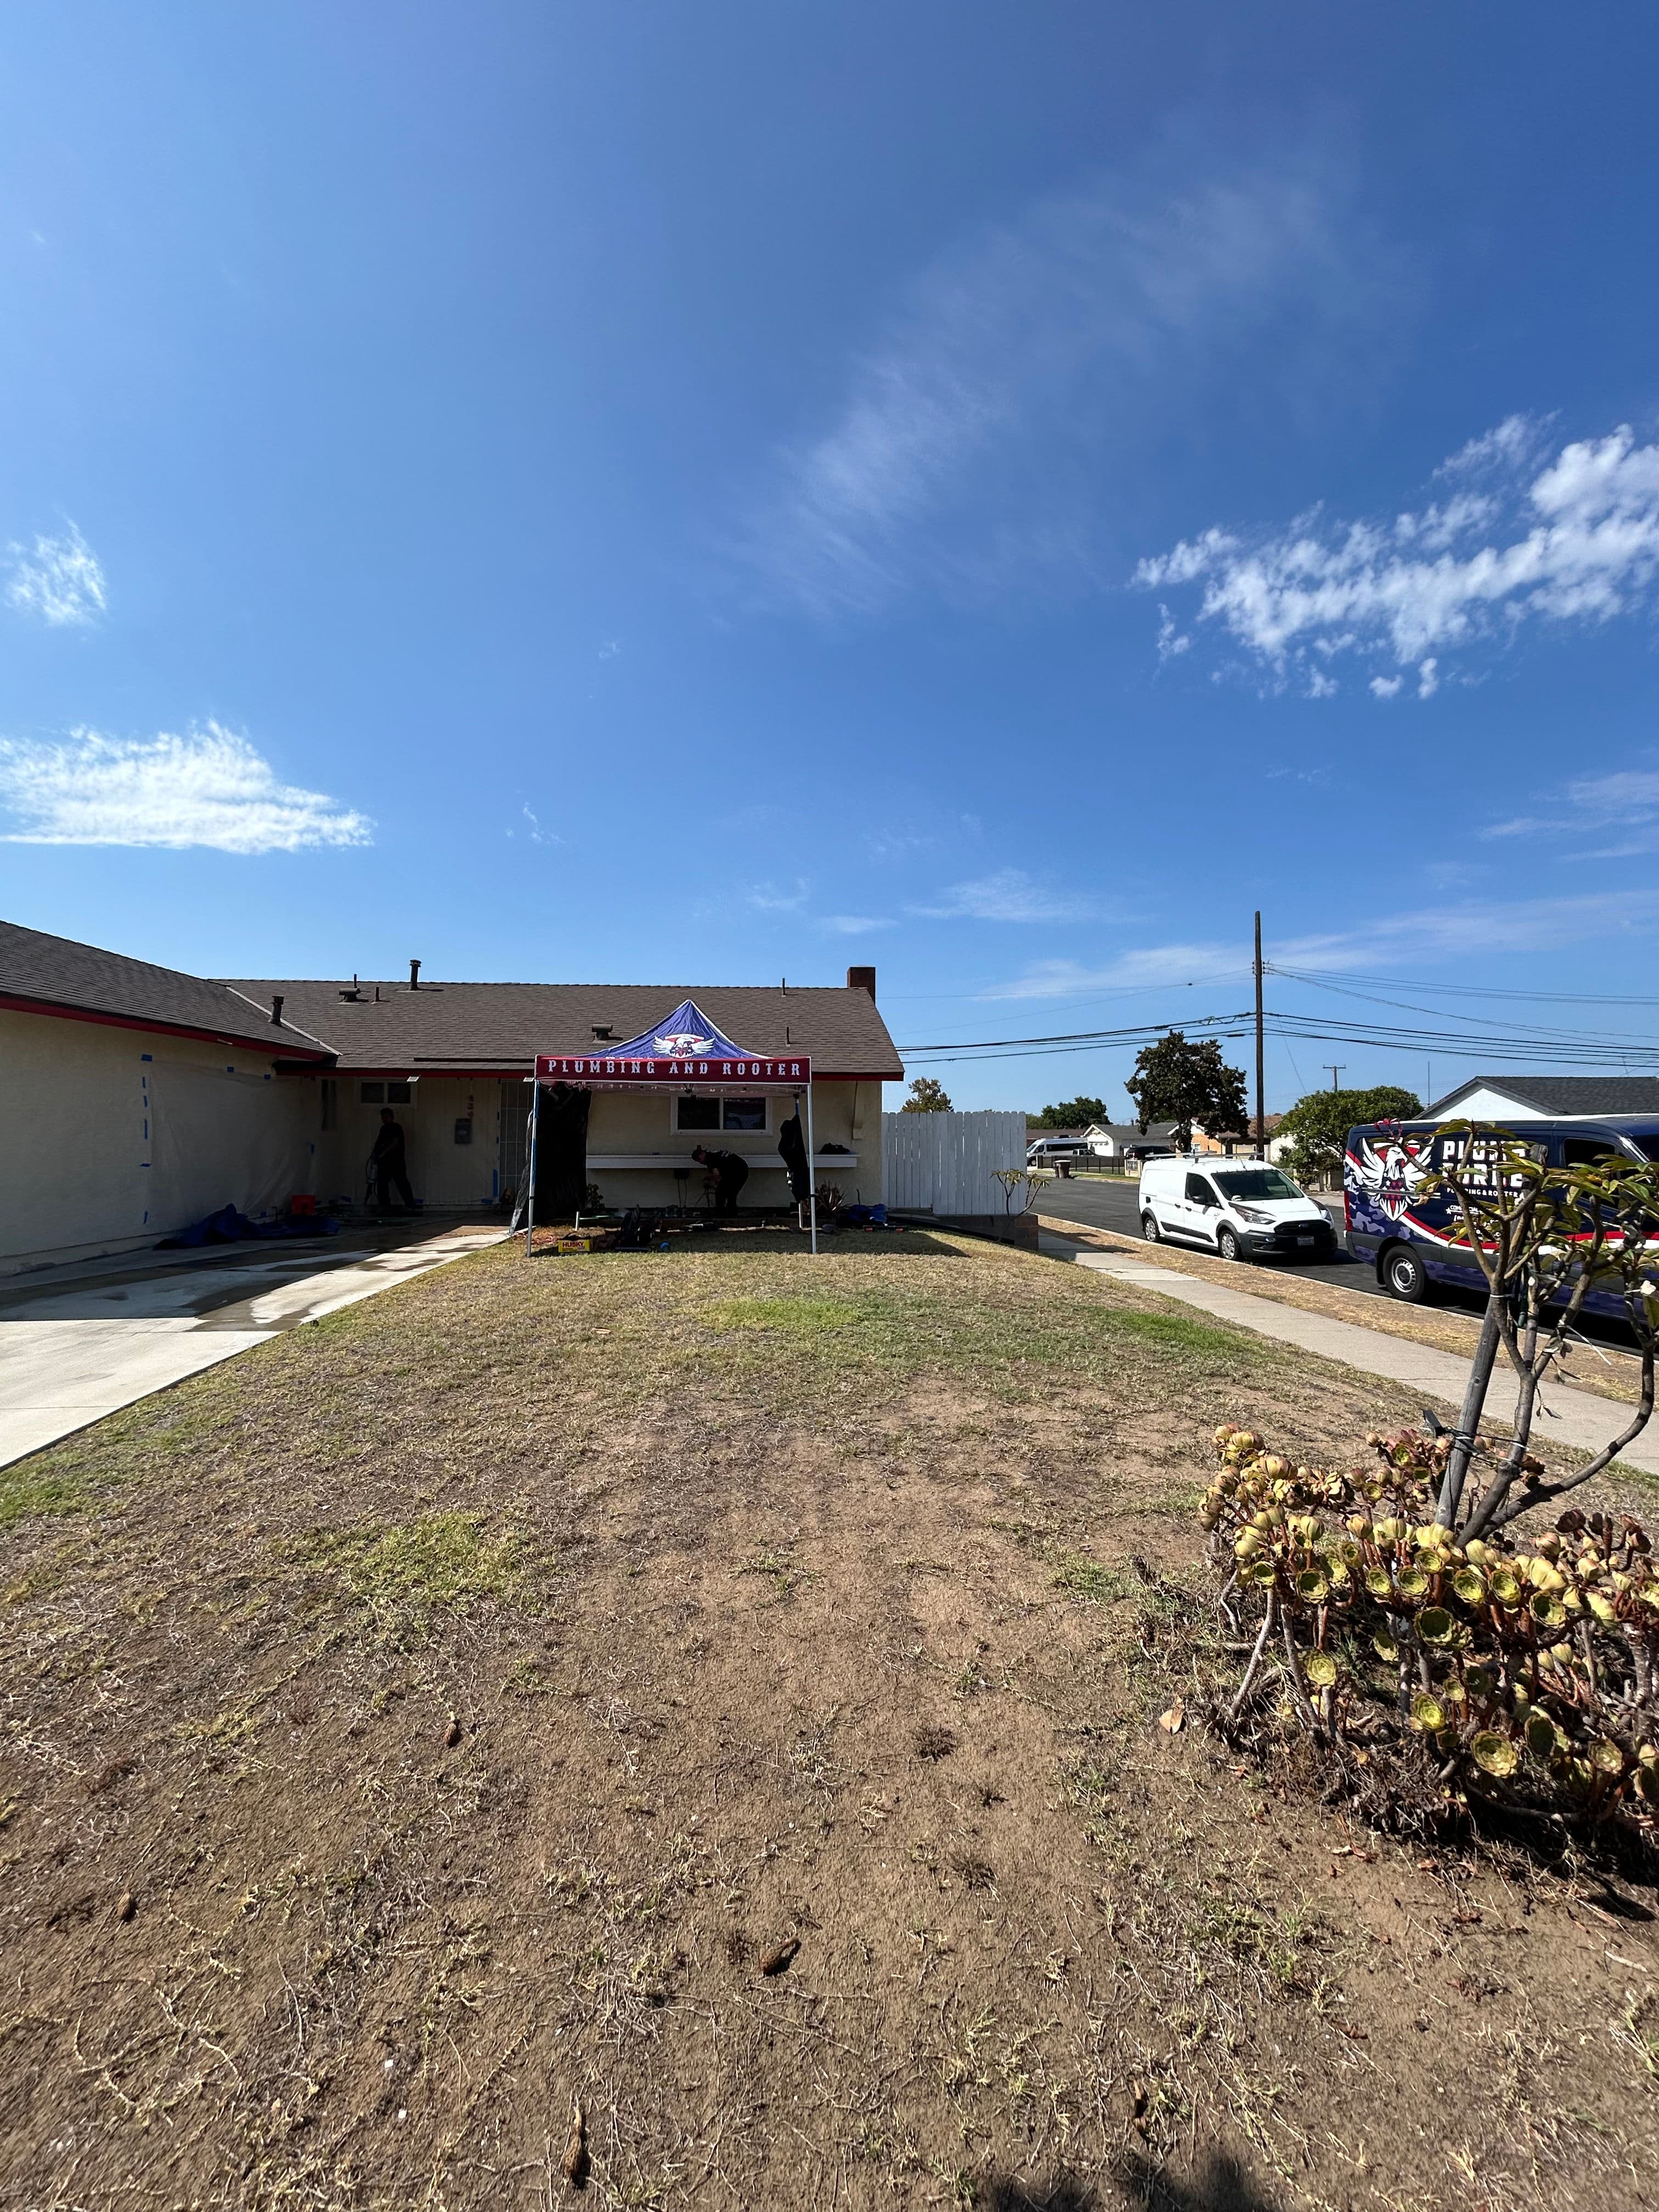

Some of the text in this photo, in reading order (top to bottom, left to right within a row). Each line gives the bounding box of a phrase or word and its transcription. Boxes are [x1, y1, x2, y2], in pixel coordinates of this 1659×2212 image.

[549, 1059, 800, 1076] PLUMBING AND ROOTER
[1488, 1189, 1518, 1198] ROTER
